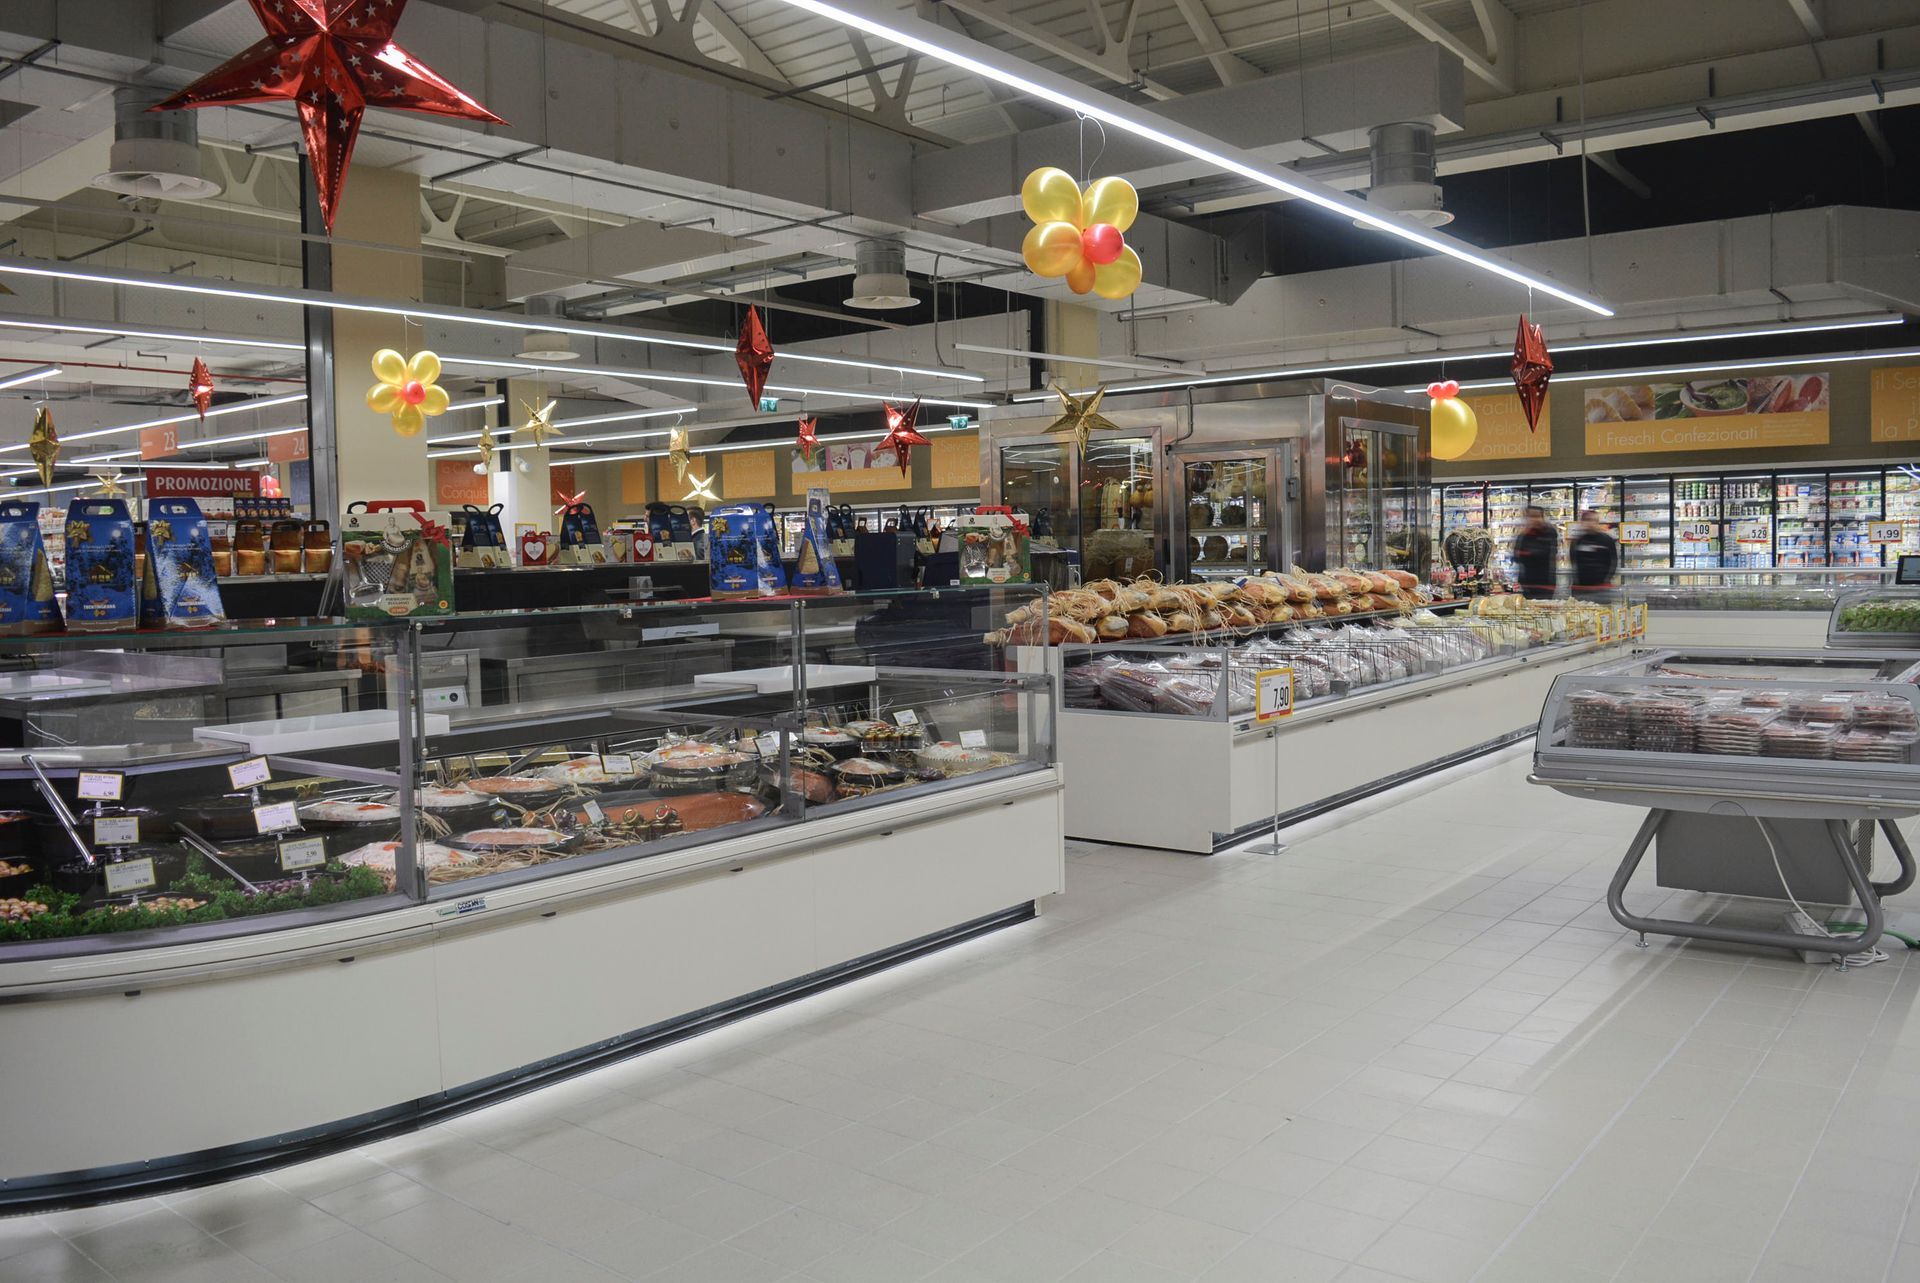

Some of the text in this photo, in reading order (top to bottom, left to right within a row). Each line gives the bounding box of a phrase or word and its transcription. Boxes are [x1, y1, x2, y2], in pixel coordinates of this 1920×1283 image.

[163, 431, 176, 451] 23
[1607, 430, 1655, 447] Freschi
[1660, 425, 1758, 445] Confezionati
[292, 437, 305, 455] 24
[155, 475, 253, 492] PROMOZIONE
[1627, 530, 1647, 539] 1,78
[1876, 529, 1900, 539] 1,99
[1273, 686, 1290, 710] 7,90
